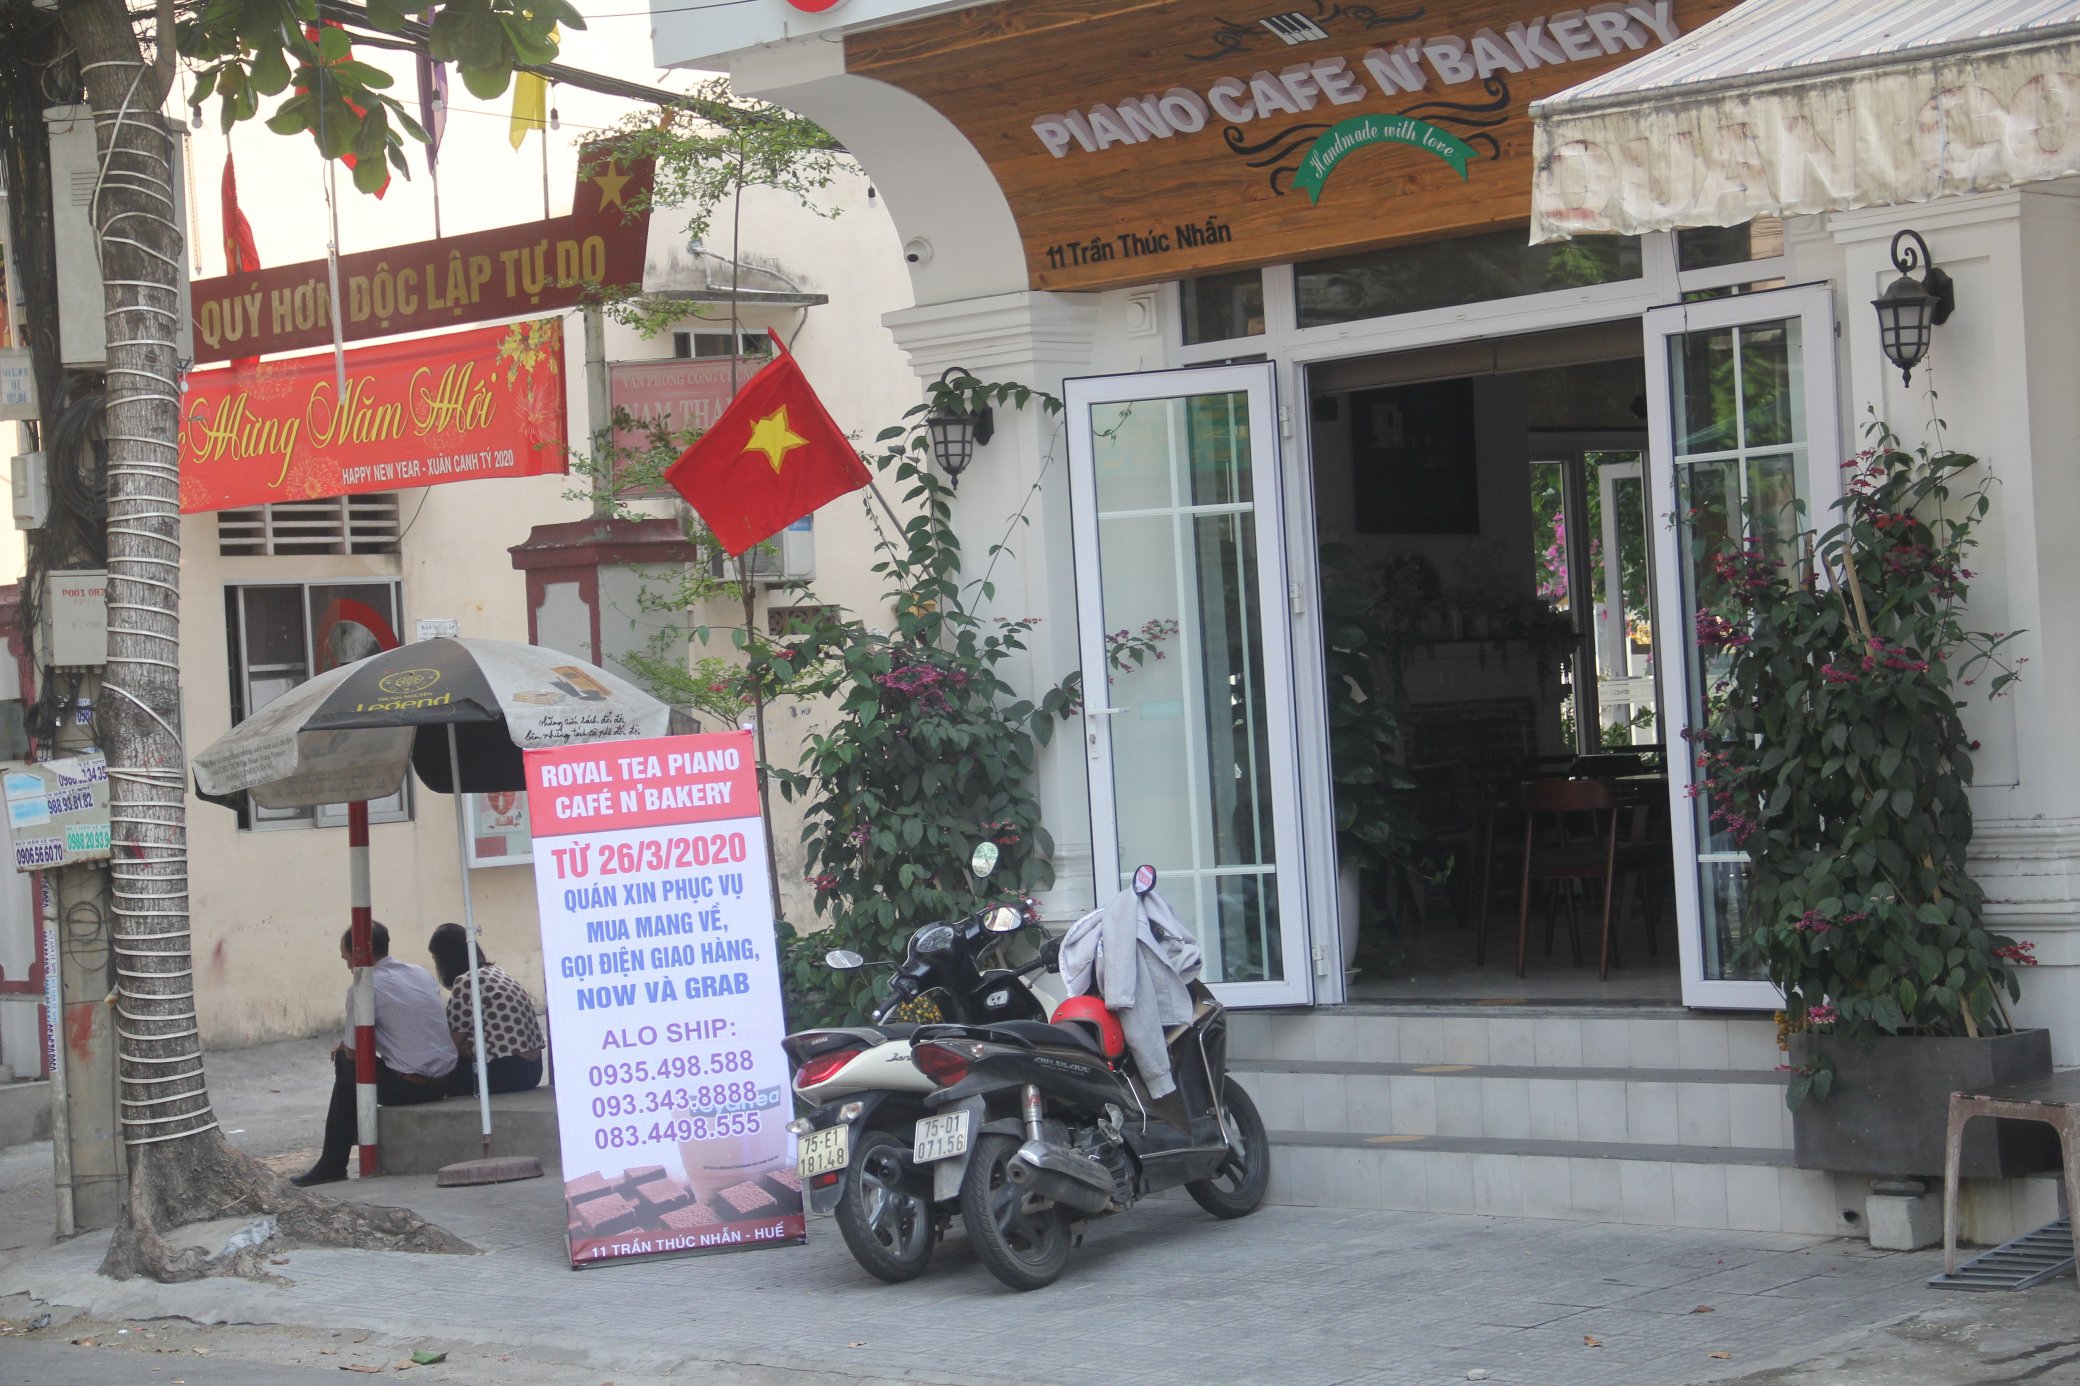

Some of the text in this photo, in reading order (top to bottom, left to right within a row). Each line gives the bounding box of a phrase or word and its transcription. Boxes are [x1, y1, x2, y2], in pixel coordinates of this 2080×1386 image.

[1031, 87, 1209, 158] PIANO
[1208, 56, 1367, 123] CAFE
[1309, 119, 1454, 178] Handmade with love
[1046, 215, 1232, 269] 11 Trần Thúc Nhẫn
[201, 235, 606, 349] QUÝ HƠN ĐỘC LẬP TỰ DO
[188, 392, 300, 487] Mừng
[306, 376, 408, 448] Năm
[409, 360, 498, 436] Mới
[341, 446, 514, 485] HAPPY NEW YEAR XUÂN CANH TÝ 2020
[541, 748, 740, 787] ROYAL TEA PIANO
[555, 788, 613, 819] CAFÉ
[67, 832, 110, 850] 0988.20.93.9
[551, 832, 747, 880] TỪ 26/3/2020
[564, 873, 744, 913] QUÁN XIN PHỤC VỤ
[586, 902, 728, 944] MUA MANG VỀ,
[561, 937, 760, 981] GỌI ĐIỆN GIAO HÀNG,
[576, 972, 750, 1010] NOW VÀ GRAB
[601, 1017, 737, 1050] ALO SHIP:
[588, 1049, 754, 1087] 0935.498.588
[591, 1080, 758, 1119] 093.343.8888
[594, 1111, 762, 1150] 083.4498.555
[804, 1130, 838, 1155] 75-E1
[918, 1134, 964, 1160] 071.56
[800, 1148, 845, 1176] 181.48
[591, 1221, 785, 1258] 11 TRẦN THÚC NHẪN HUẾ
